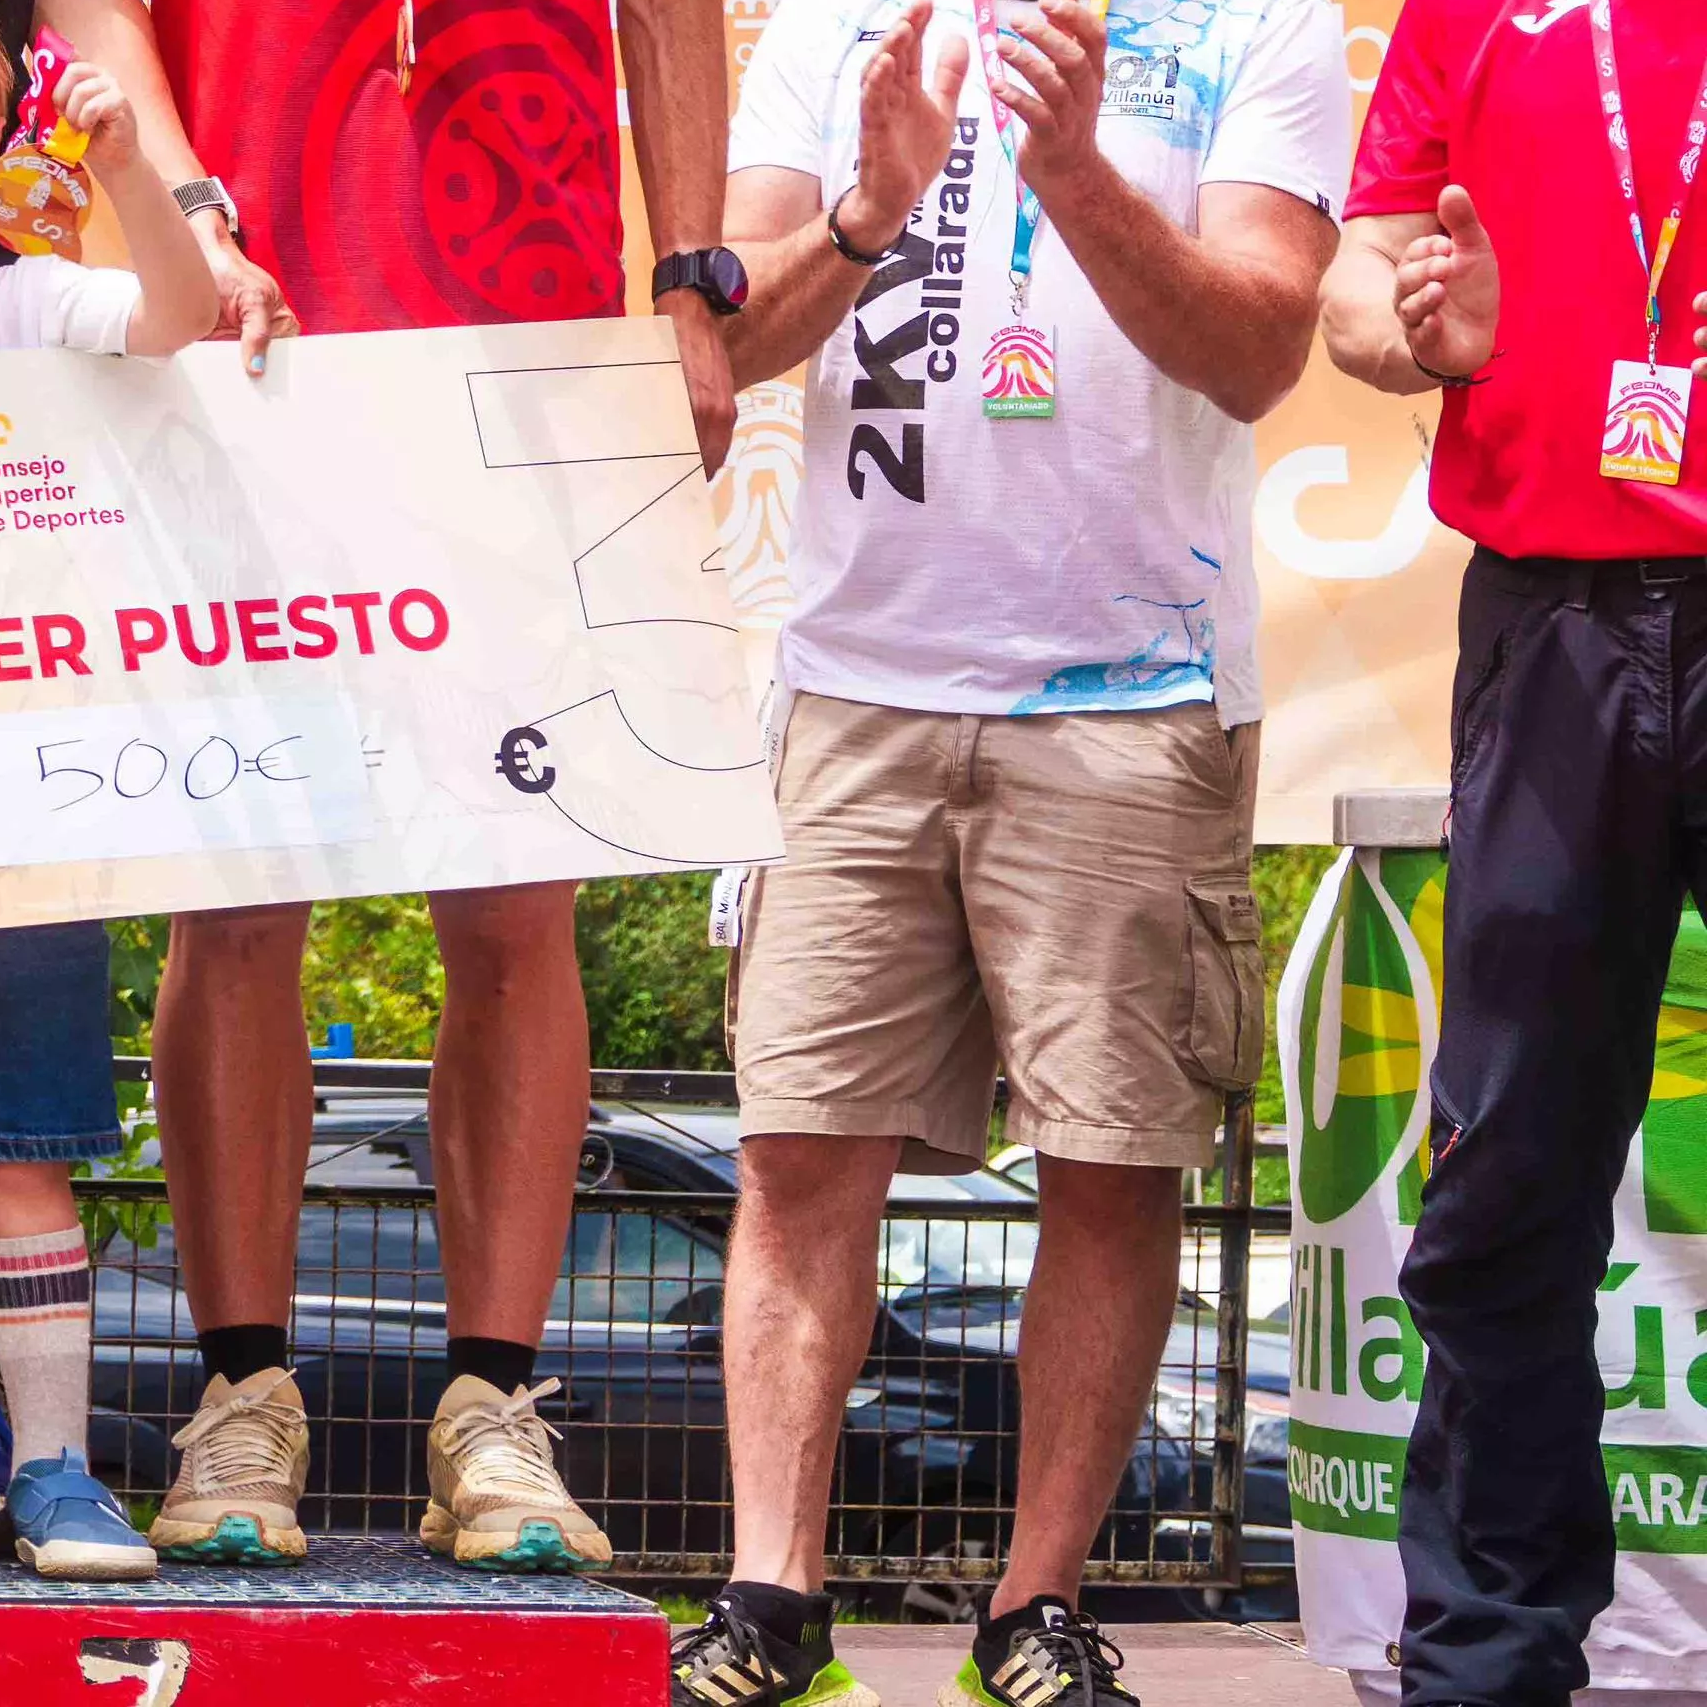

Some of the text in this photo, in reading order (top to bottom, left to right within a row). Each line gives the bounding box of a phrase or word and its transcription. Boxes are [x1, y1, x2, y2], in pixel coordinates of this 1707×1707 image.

[925, 115, 979, 384] collarada
[12, 502, 126, 535] Deportes
[117, 586, 451, 675] PUESTO
[35, 733, 311, 811] 500€
[494, 725, 556, 795] €
